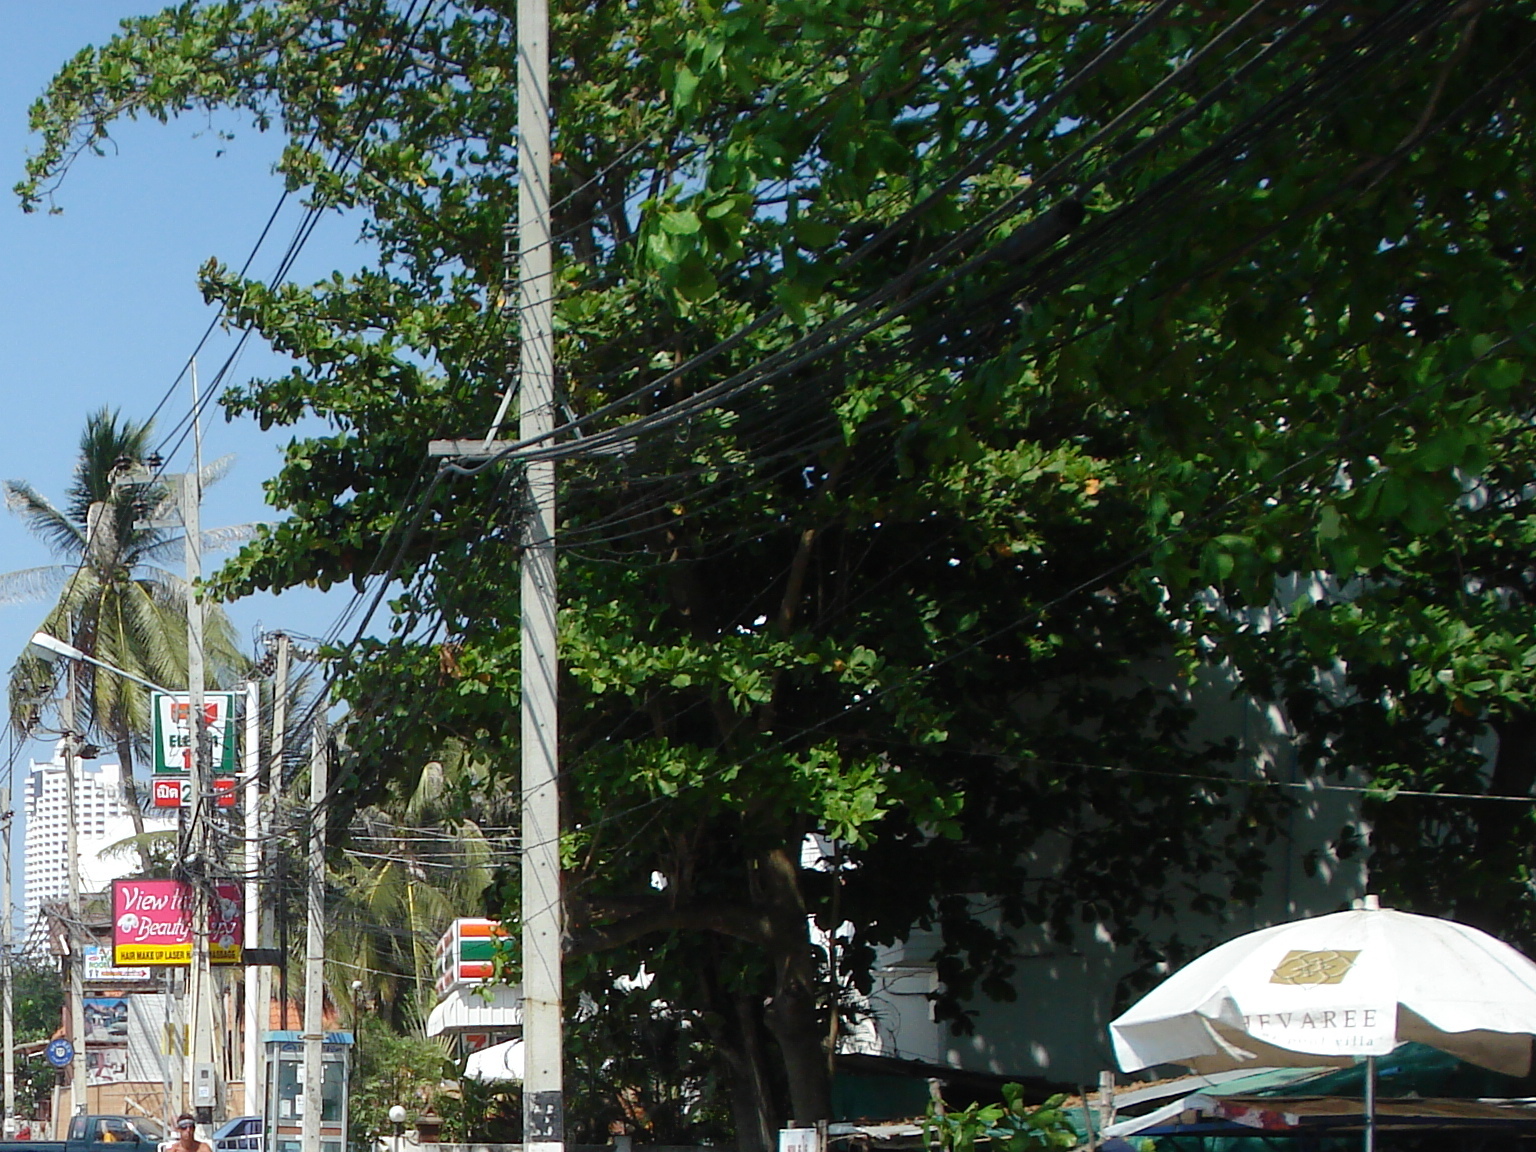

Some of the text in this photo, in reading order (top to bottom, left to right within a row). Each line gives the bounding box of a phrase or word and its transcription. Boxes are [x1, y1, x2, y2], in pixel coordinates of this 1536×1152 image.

[122, 887, 170, 911] View
[134, 916, 190, 942] Beauty
[120, 951, 135, 961] HAIR
[136, 951, 154, 960] MAKE
[155, 951, 164, 960] UP
[165, 951, 185, 960] LASER
[1335, 1035, 1374, 1047] villa
